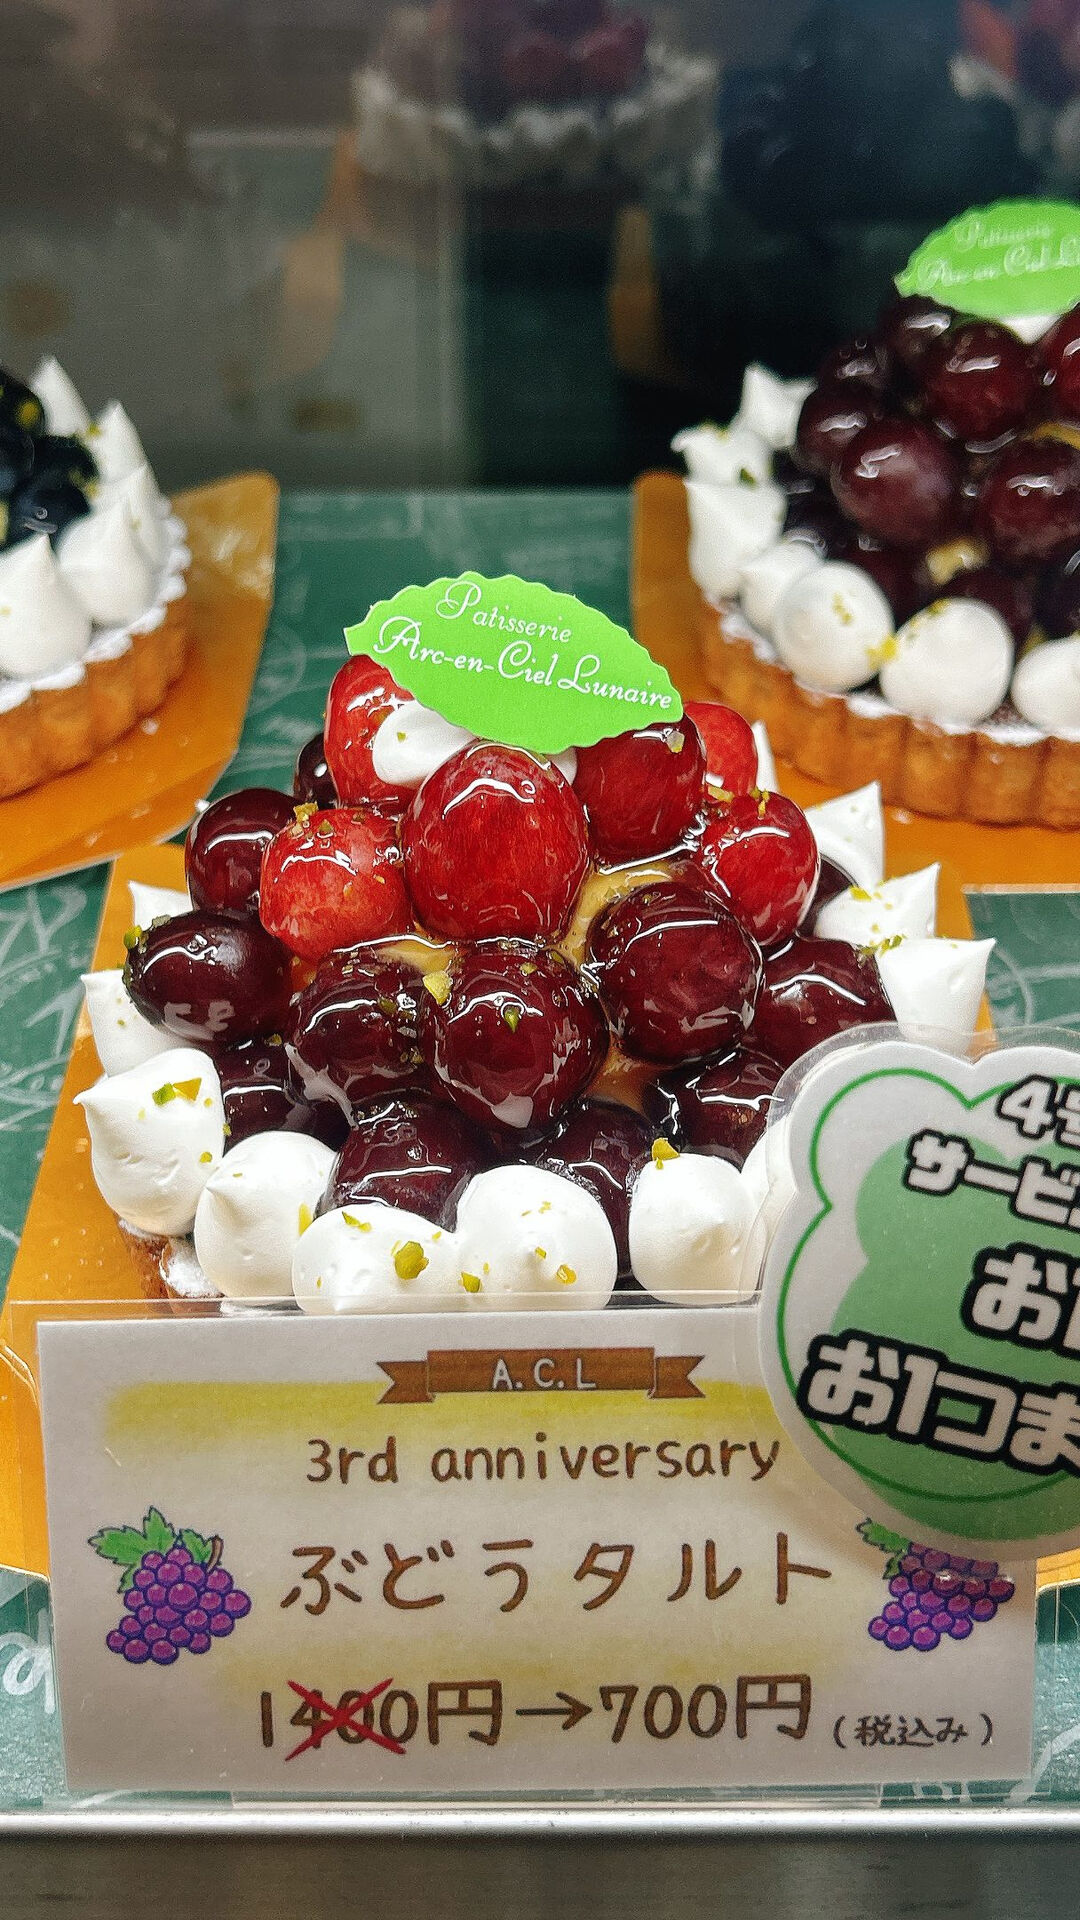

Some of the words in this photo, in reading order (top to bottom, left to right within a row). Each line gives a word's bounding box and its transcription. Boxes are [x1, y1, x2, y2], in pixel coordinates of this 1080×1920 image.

[435, 580, 573, 644] Patisserie
[372, 615, 559, 687] Arc-en-Ciel
[557, 654, 673, 710] Lunaire
[903, 1128, 1080, 1234] サービ
[306, 1436, 398, 1484] 3rd
[431, 1432, 781, 1481] anniversary
[280, 1531, 833, 1616] ぶどうタルト
[599, 1673, 812, 1744] 700円
